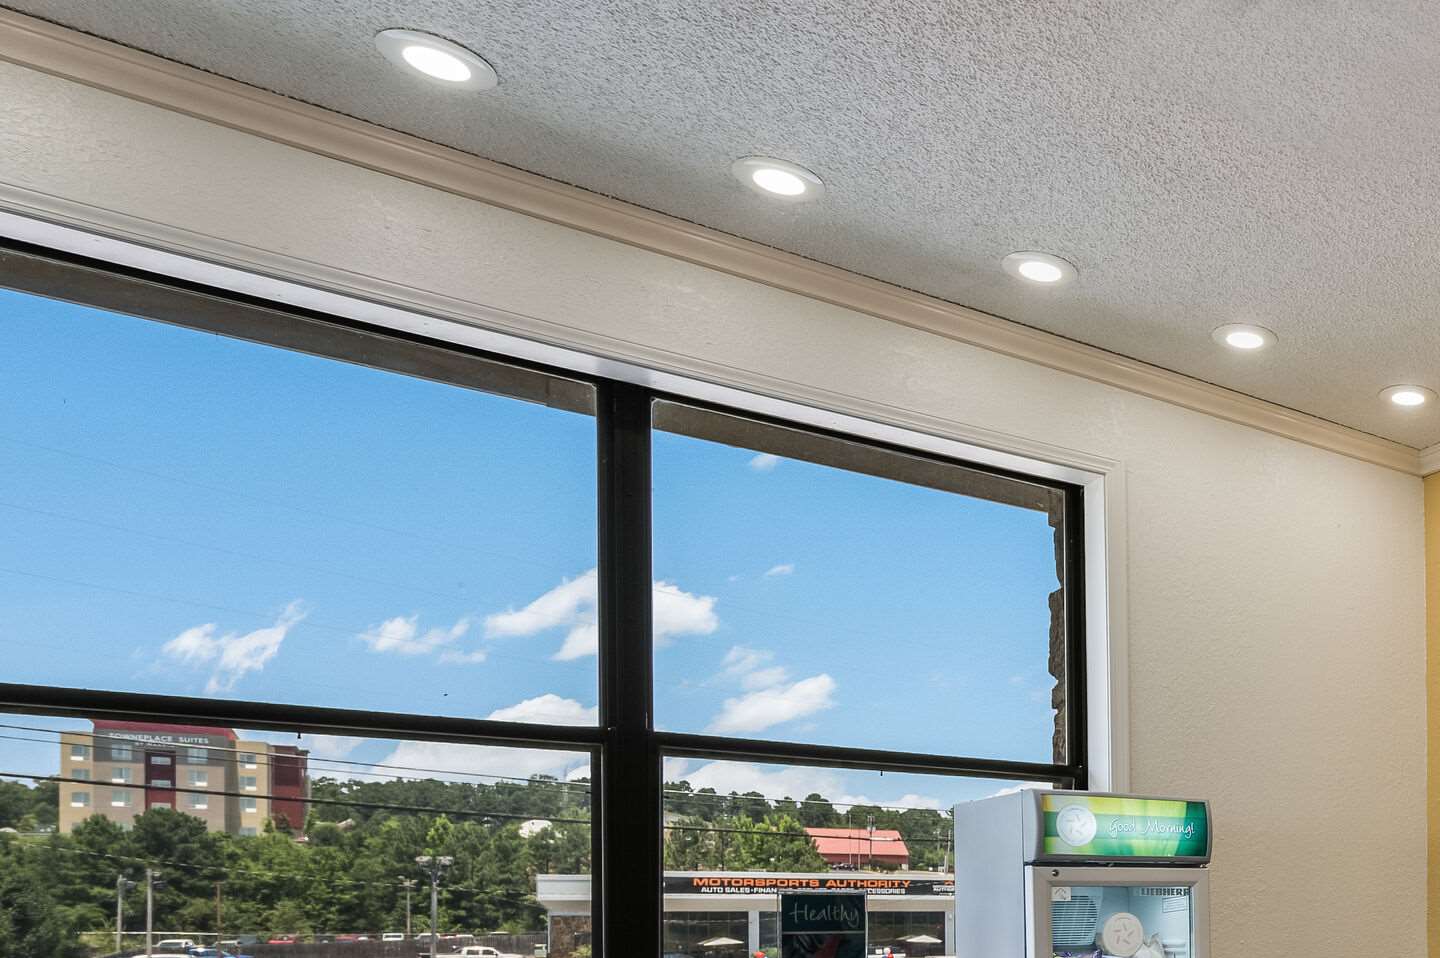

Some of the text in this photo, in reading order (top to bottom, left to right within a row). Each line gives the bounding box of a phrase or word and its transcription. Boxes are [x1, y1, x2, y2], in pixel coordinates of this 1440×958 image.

[1109, 815, 1195, 839] Good Morning!
[693, 878, 911, 888] MOTORSPORTS AUTHORITY
[701, 886, 724, 894] AUTO
[788, 902, 860, 928] Healthy
